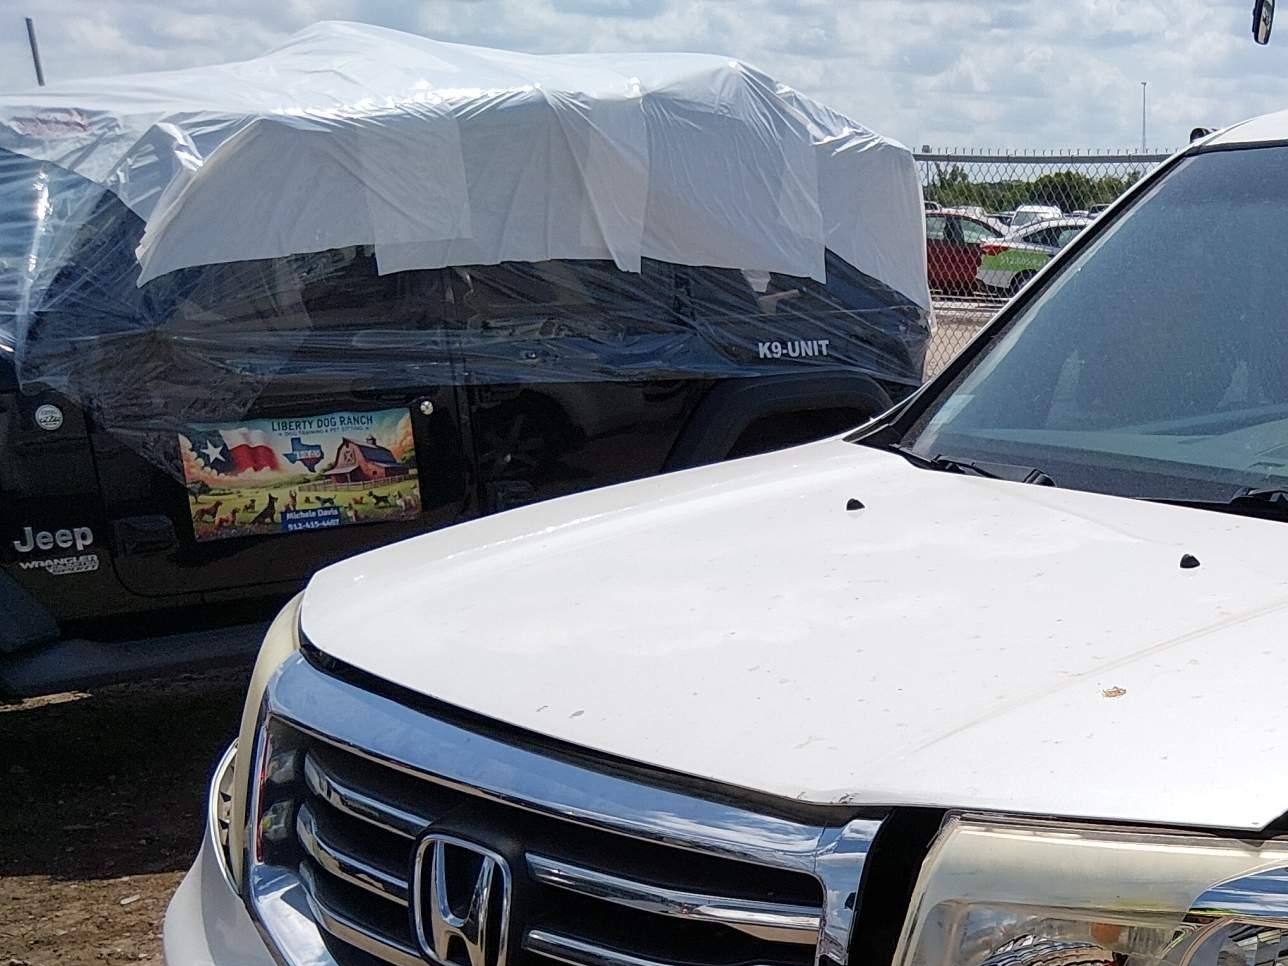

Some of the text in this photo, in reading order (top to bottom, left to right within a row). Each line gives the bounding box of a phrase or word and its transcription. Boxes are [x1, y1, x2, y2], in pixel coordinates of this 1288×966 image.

[758, 339, 830, 359] K9-UNIT
[271, 415, 374, 432] LIBERTY DOG RANCH
[12, 526, 94, 552] Jeep
[19, 554, 98, 570] WRANGLER
